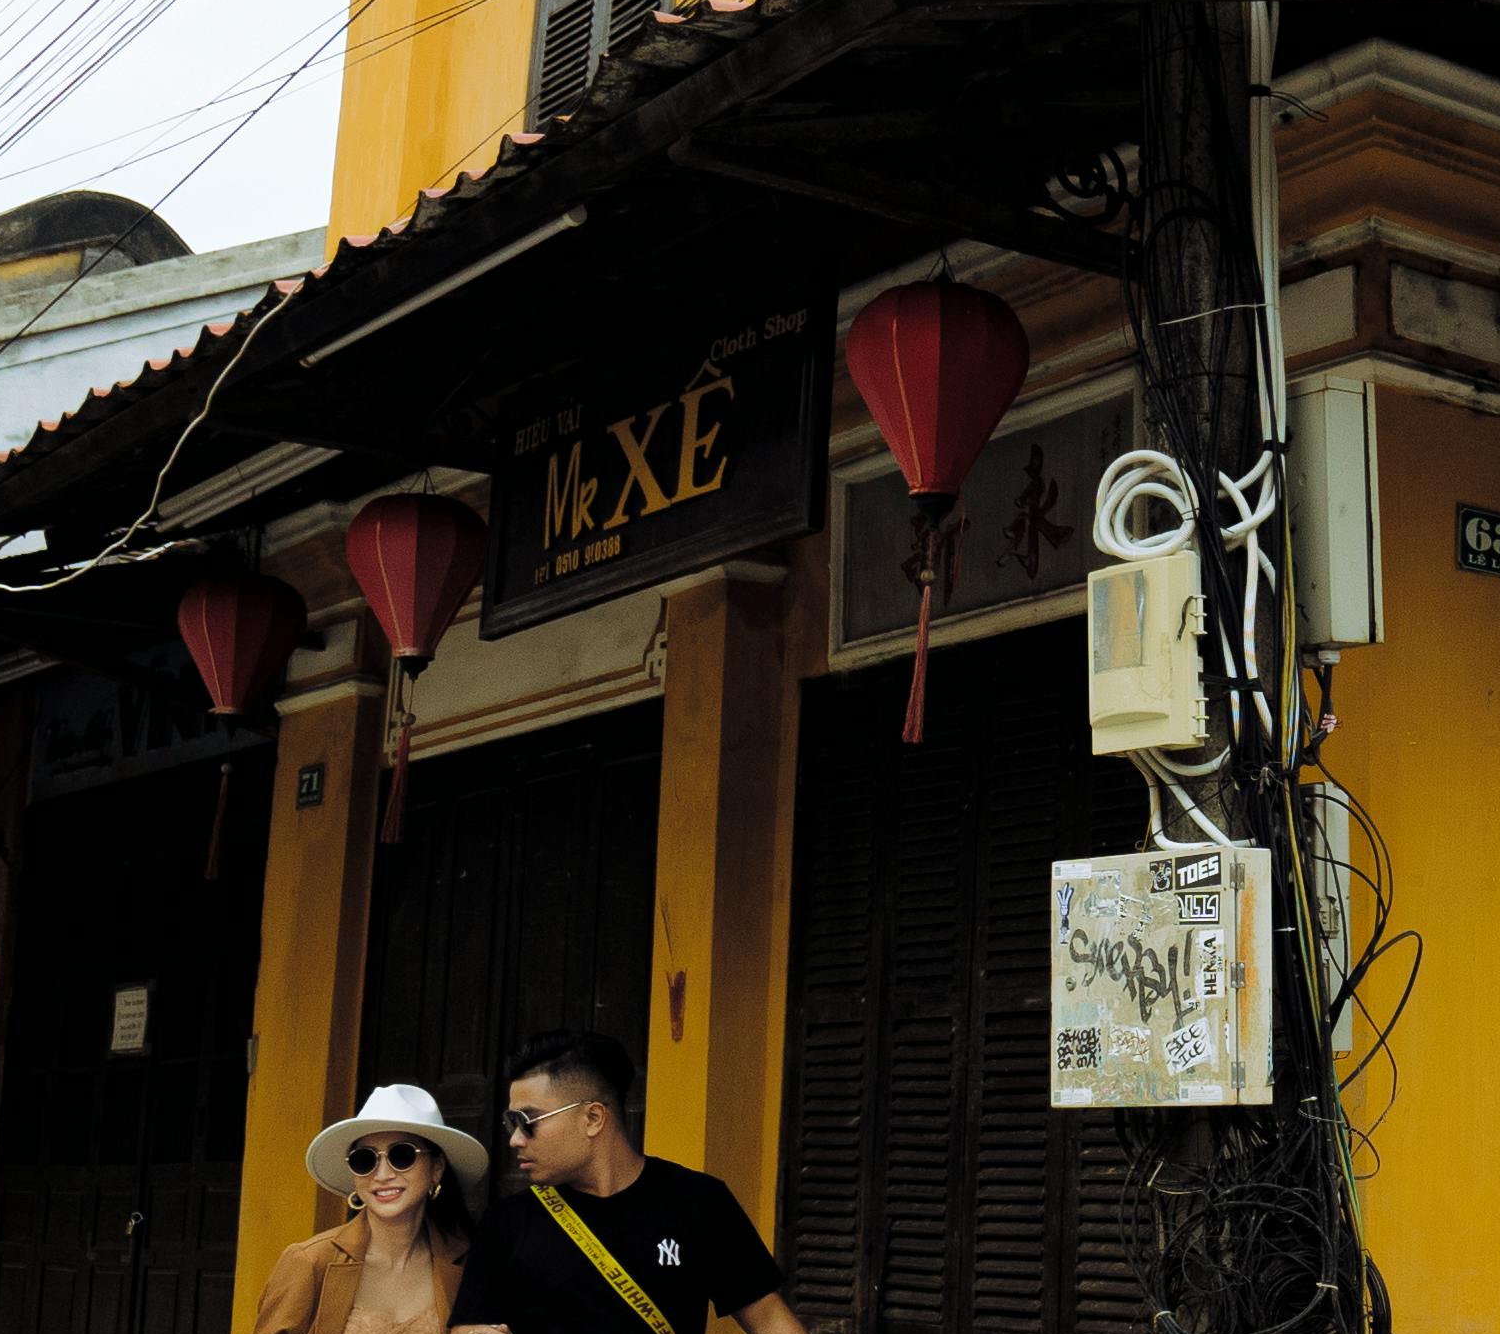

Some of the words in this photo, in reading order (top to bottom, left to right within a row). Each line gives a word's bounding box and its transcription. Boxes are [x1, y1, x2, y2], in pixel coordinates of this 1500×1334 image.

[710, 327, 757, 363] Cloth
[763, 308, 809, 341] Shop
[602, 358, 739, 531] XÊ
[1468, 553, 1487, 566] LÊ
[301, 770, 318, 793] 71
[1177, 855, 1219, 887] TOES
[657, 1238, 681, 1266] NY
